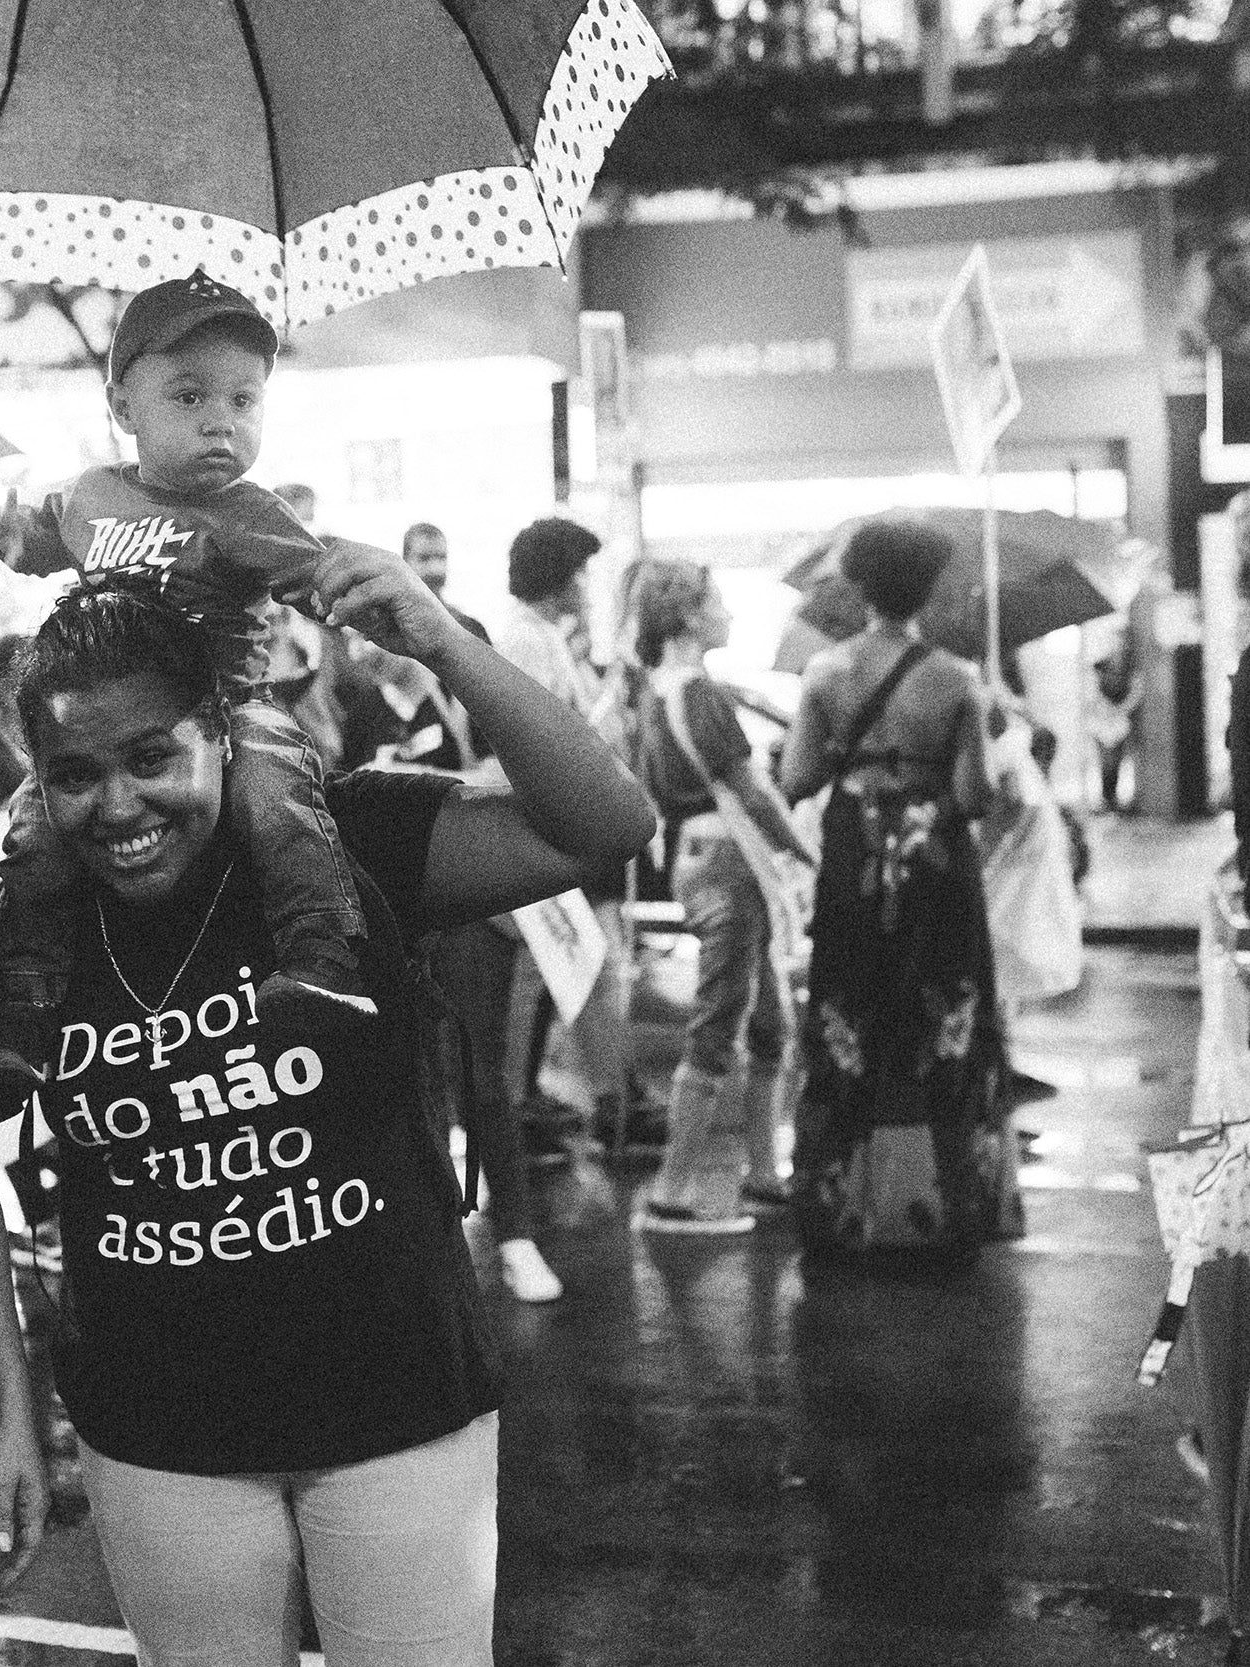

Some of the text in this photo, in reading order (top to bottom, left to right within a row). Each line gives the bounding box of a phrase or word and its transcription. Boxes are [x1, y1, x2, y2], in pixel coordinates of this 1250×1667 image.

[56, 966, 260, 1081] Depoi
[64, 1044, 323, 1147] do não
[142, 1126, 313, 1190] tudo
[98, 1177, 384, 1266] assédio.
